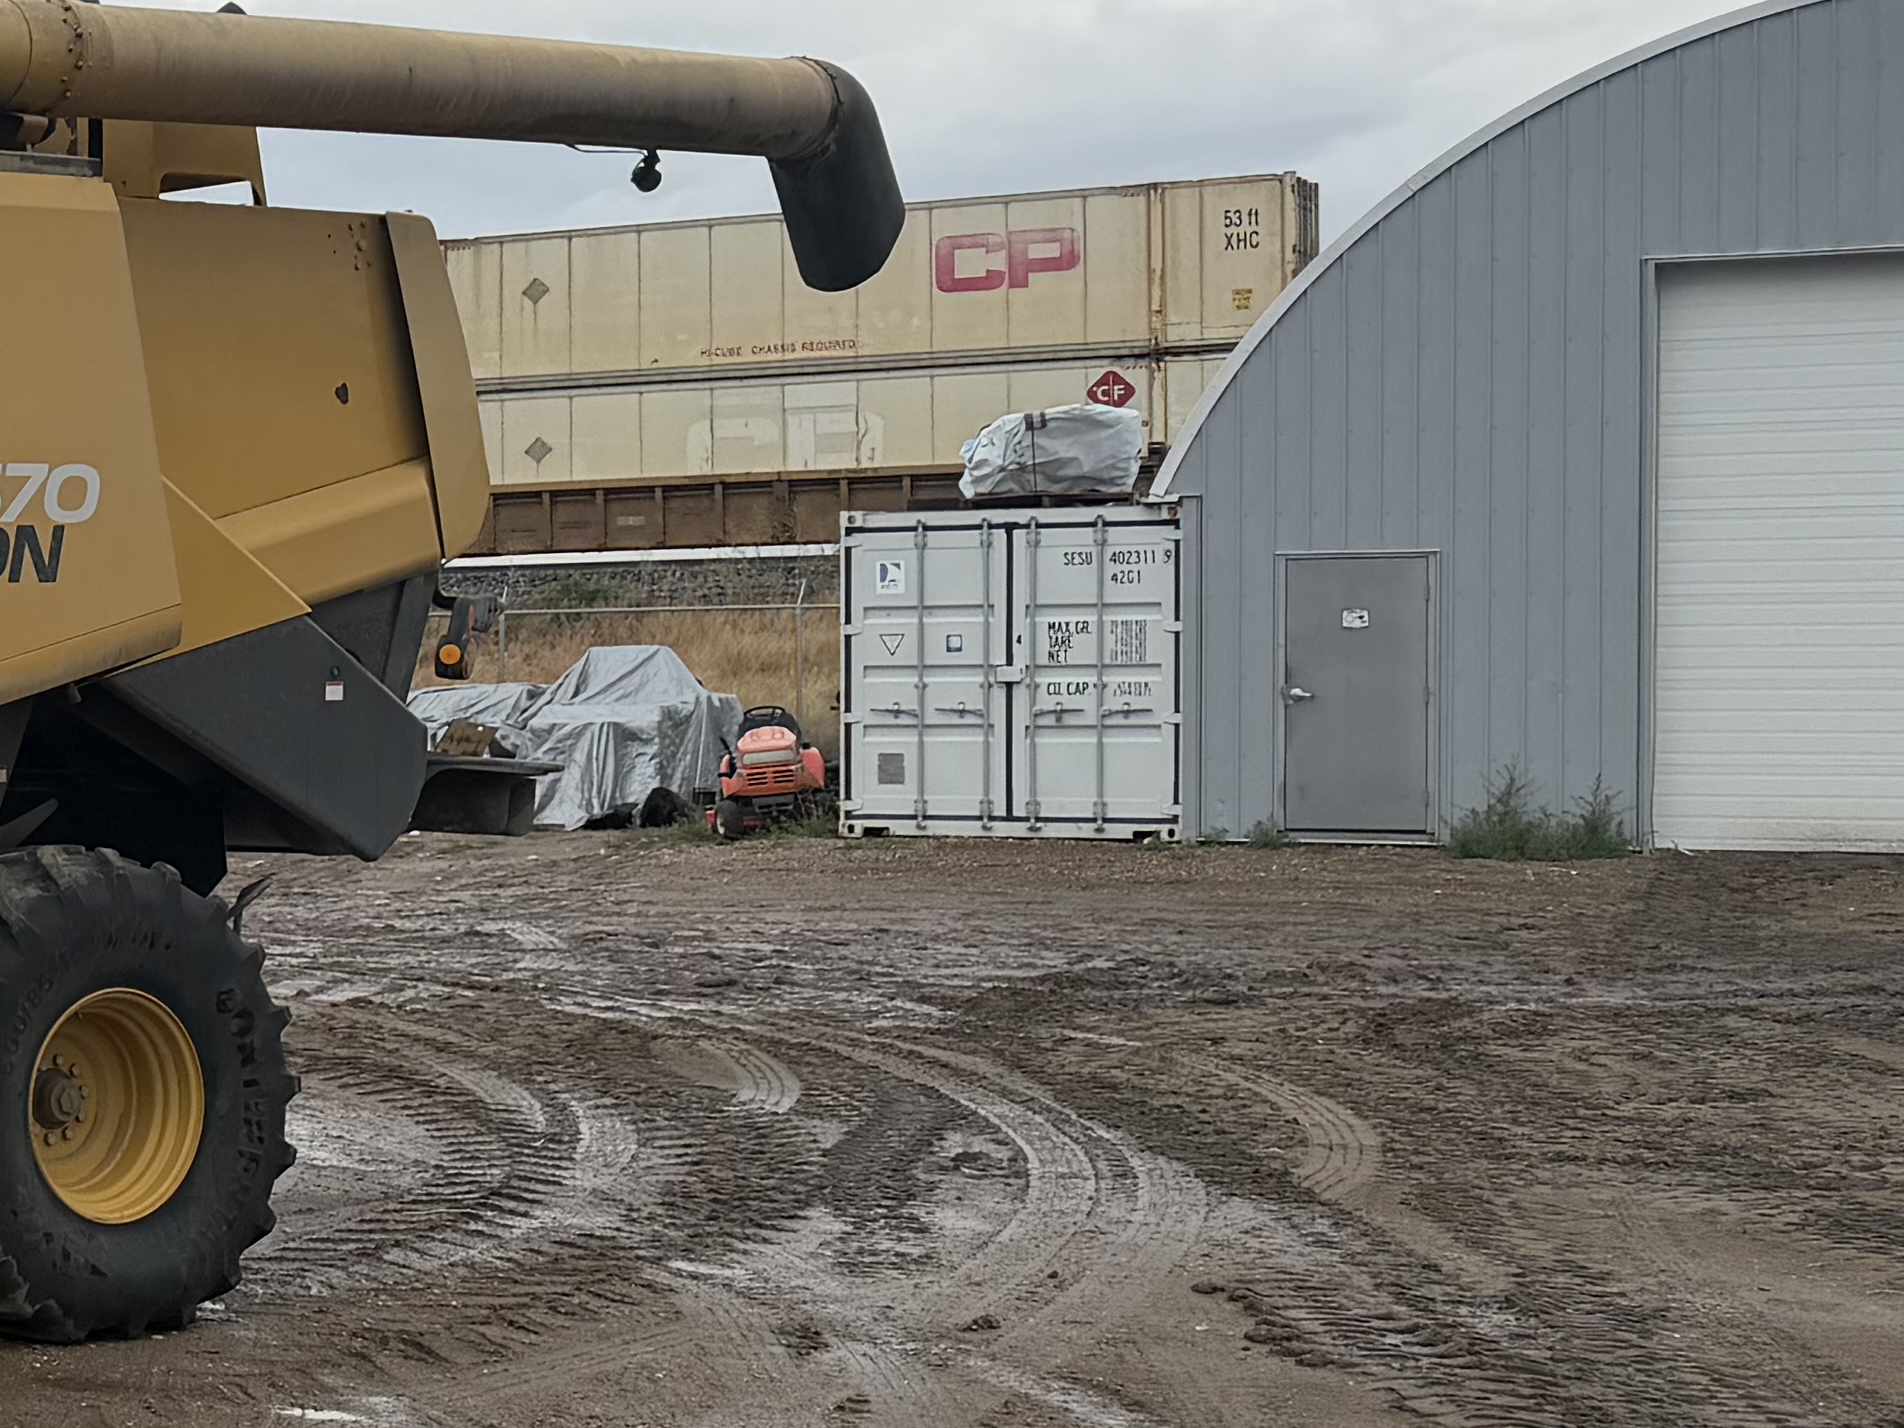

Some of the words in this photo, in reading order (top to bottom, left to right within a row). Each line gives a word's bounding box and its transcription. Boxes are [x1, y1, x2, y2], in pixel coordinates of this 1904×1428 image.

[1224, 209, 1242, 228] 53
[1248, 208, 1260, 227] ft
[1224, 230, 1260, 251] XHC
[935, 227, 1081, 293] CP
[1063, 551, 1093, 566] SESU
[1109, 549, 1156, 565] 402311
[1048, 635, 1073, 649] TARE
[1048, 649, 1068, 663] NET
